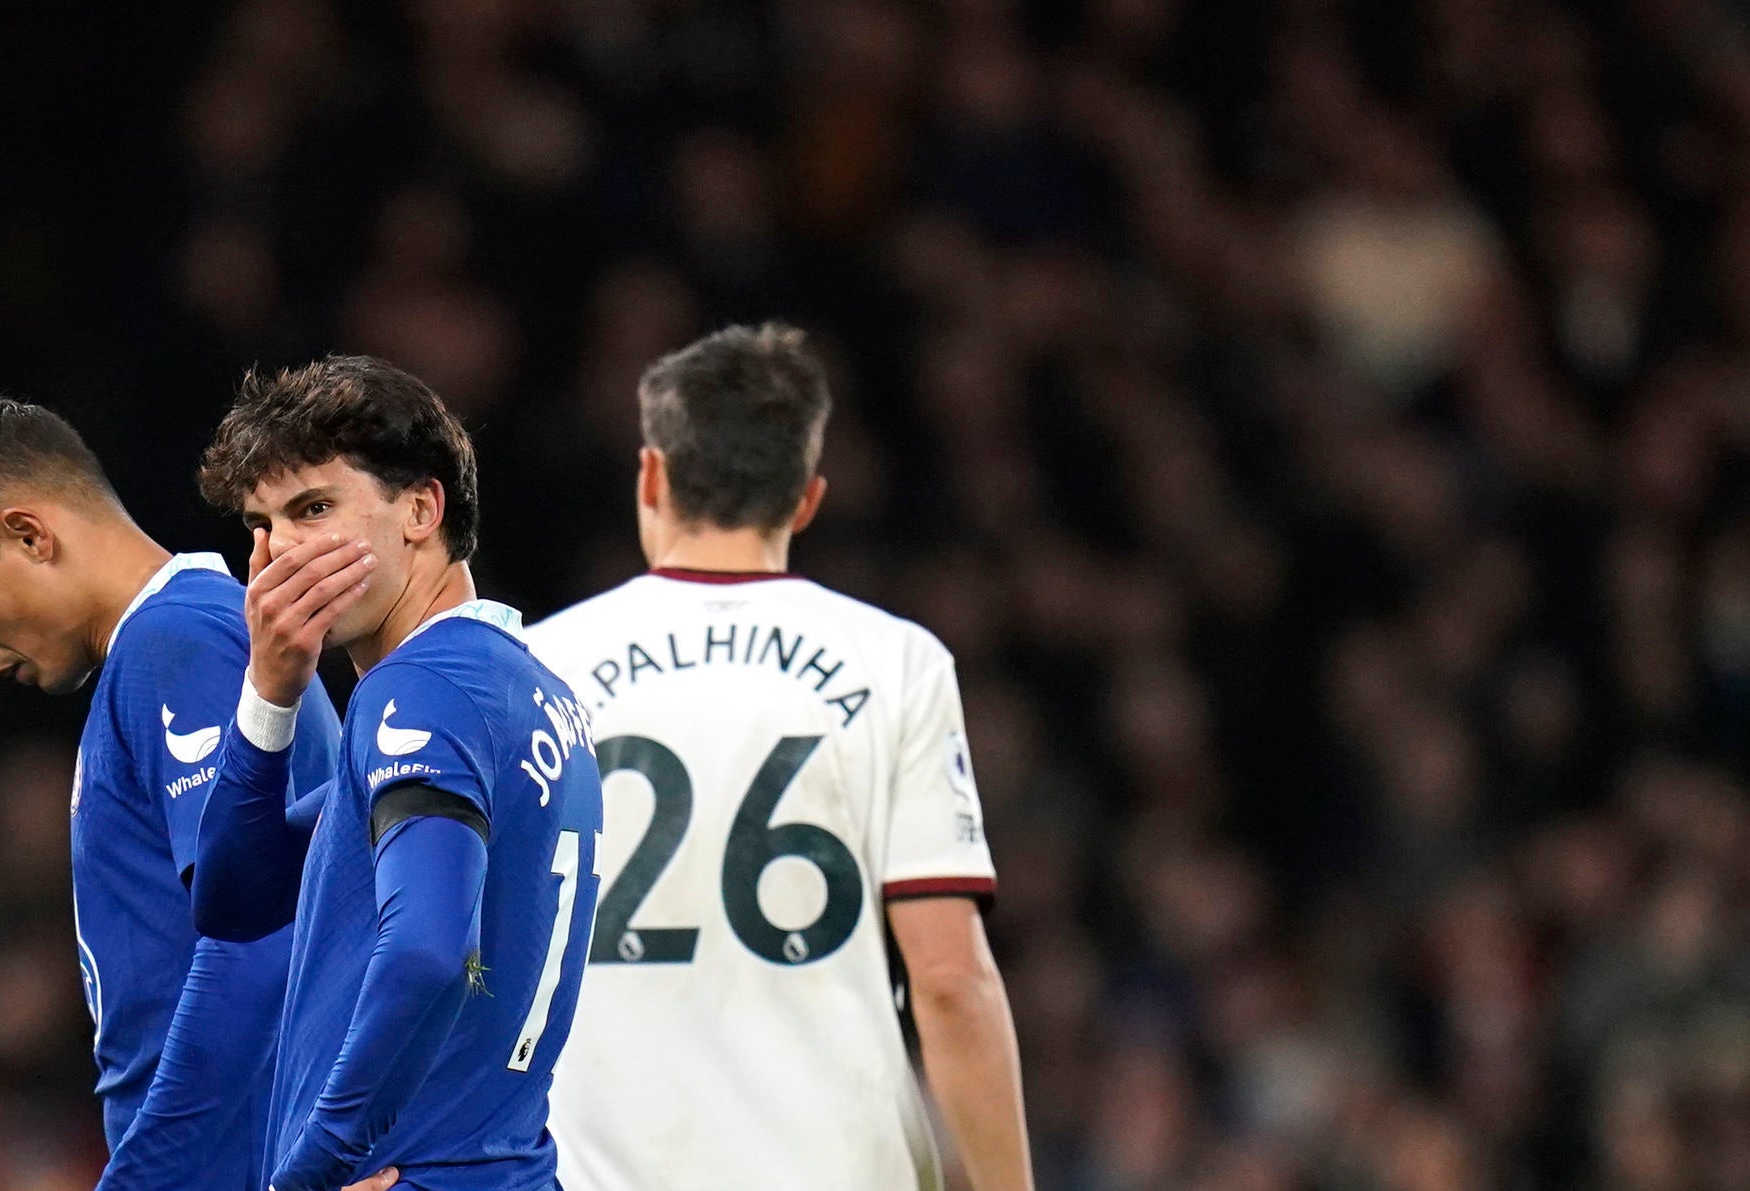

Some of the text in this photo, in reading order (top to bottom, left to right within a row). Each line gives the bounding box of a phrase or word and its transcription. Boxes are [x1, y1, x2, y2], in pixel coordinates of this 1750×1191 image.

[591, 624, 874, 728] .PALHINHA
[166, 767, 217, 799] Whale
[367, 761, 441, 789] WhaleFin
[588, 734, 864, 966] 26
